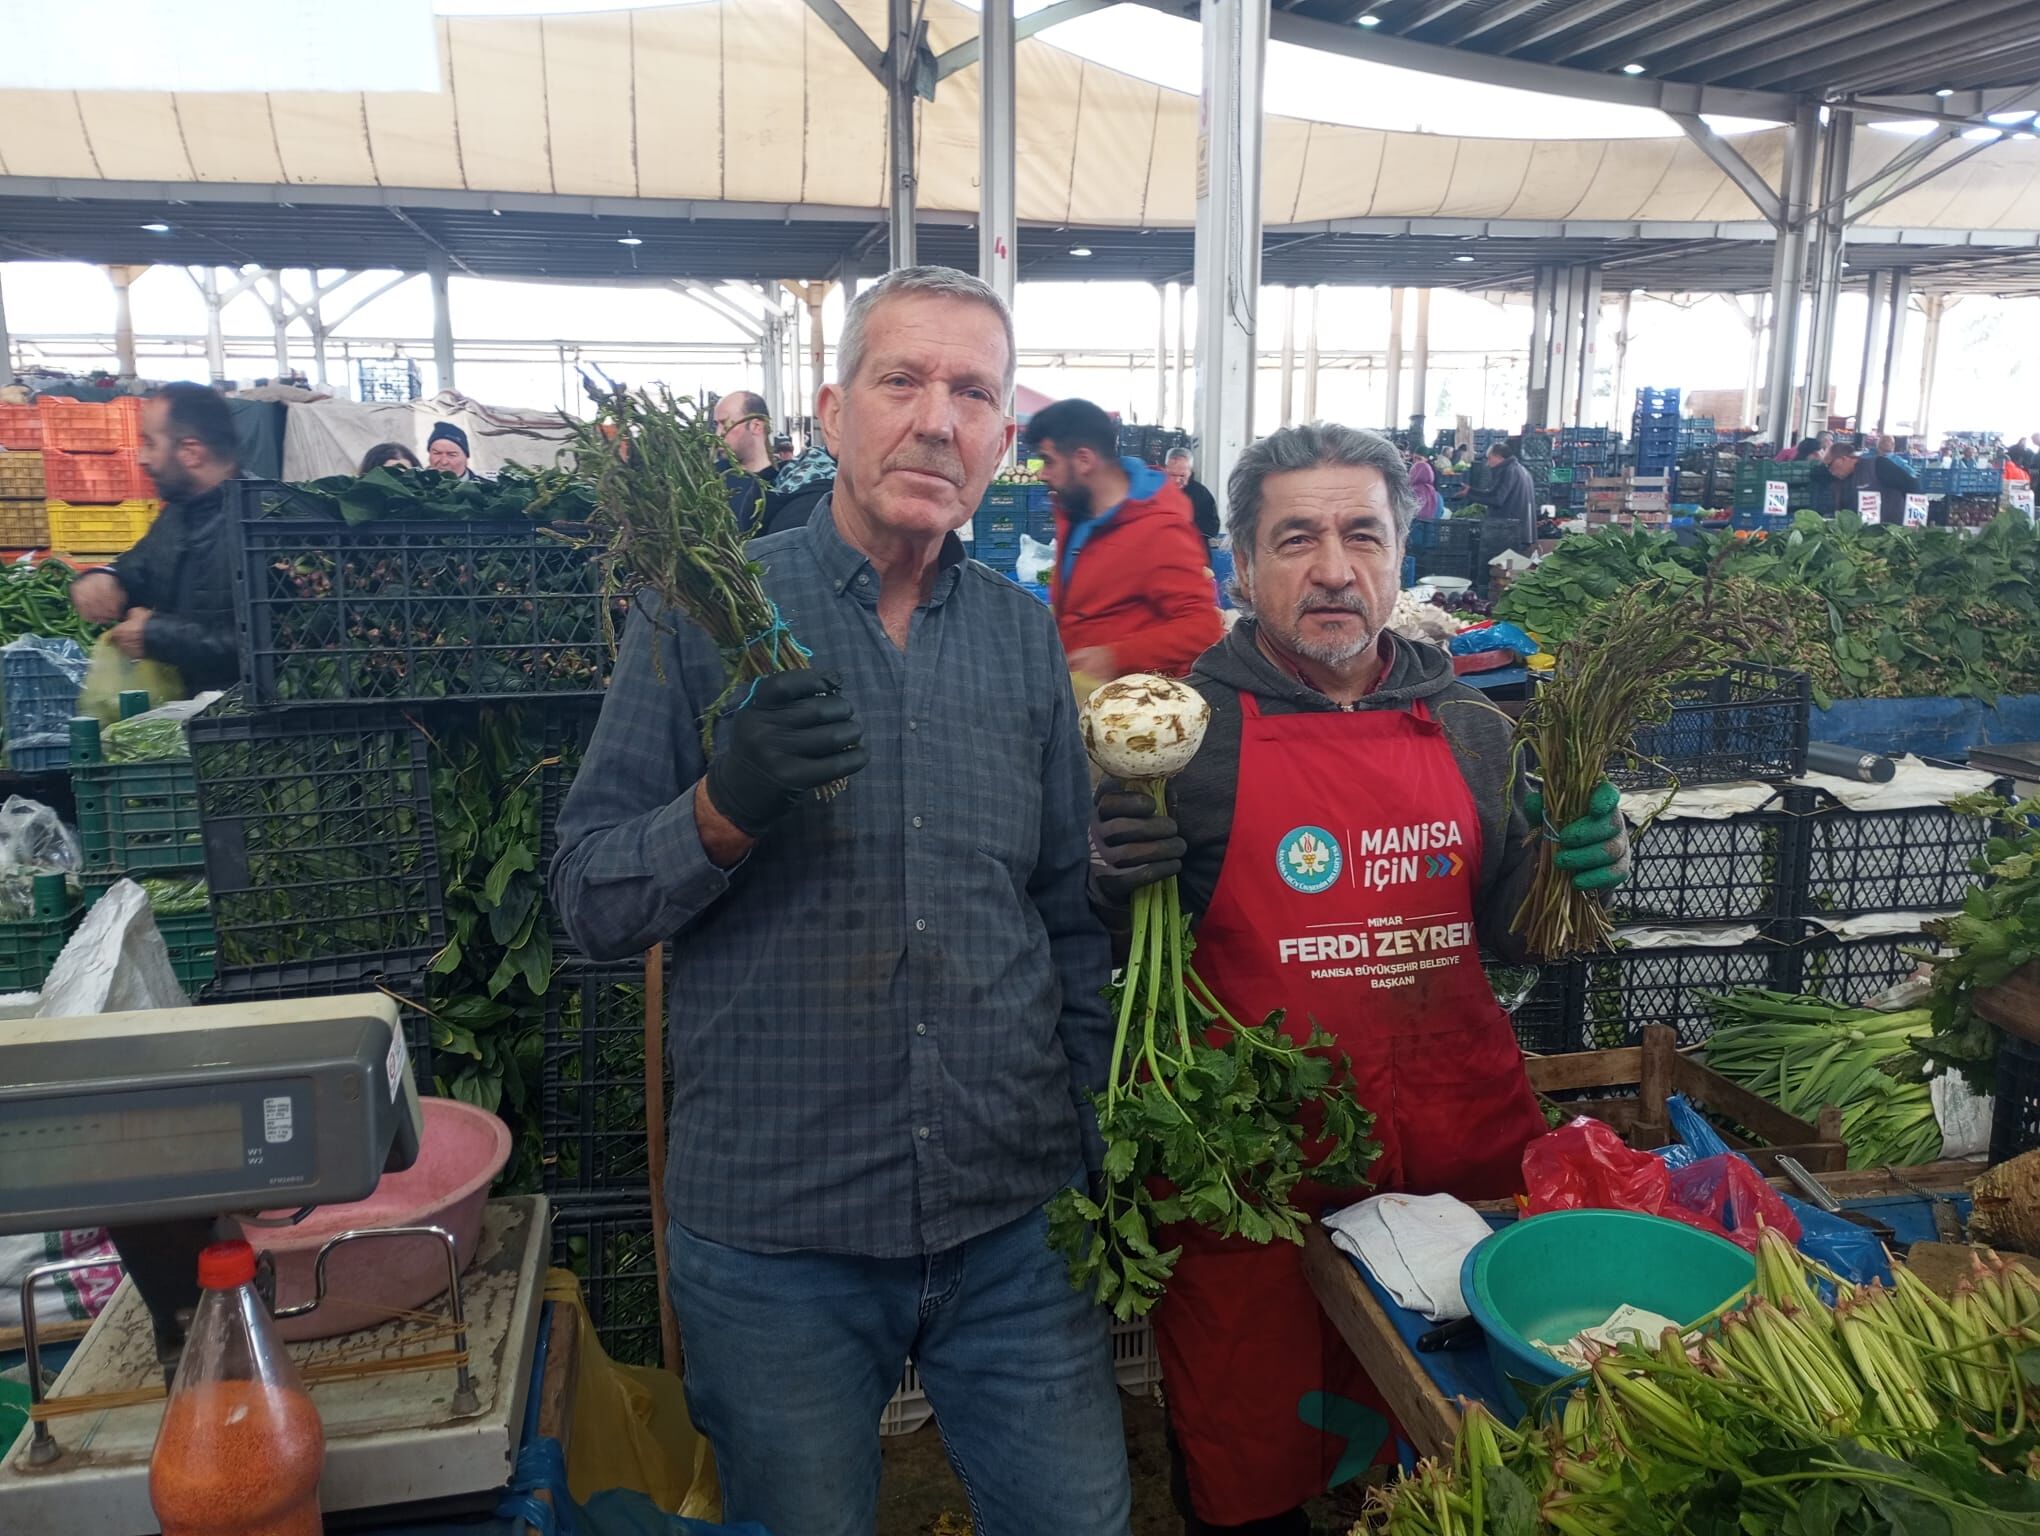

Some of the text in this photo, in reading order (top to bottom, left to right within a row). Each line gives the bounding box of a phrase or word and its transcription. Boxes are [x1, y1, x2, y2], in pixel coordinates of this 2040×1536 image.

[995, 236, 1006, 259] 4
[1360, 820, 1463, 857] MANİSA
[1364, 855, 1419, 892] İÇİN
[1367, 915, 1403, 928] MİMAR
[1279, 932, 1370, 963] FERDİ
[1311, 967, 1354, 979] MANİSA
[1370, 975, 1416, 989] BAŞKANI
